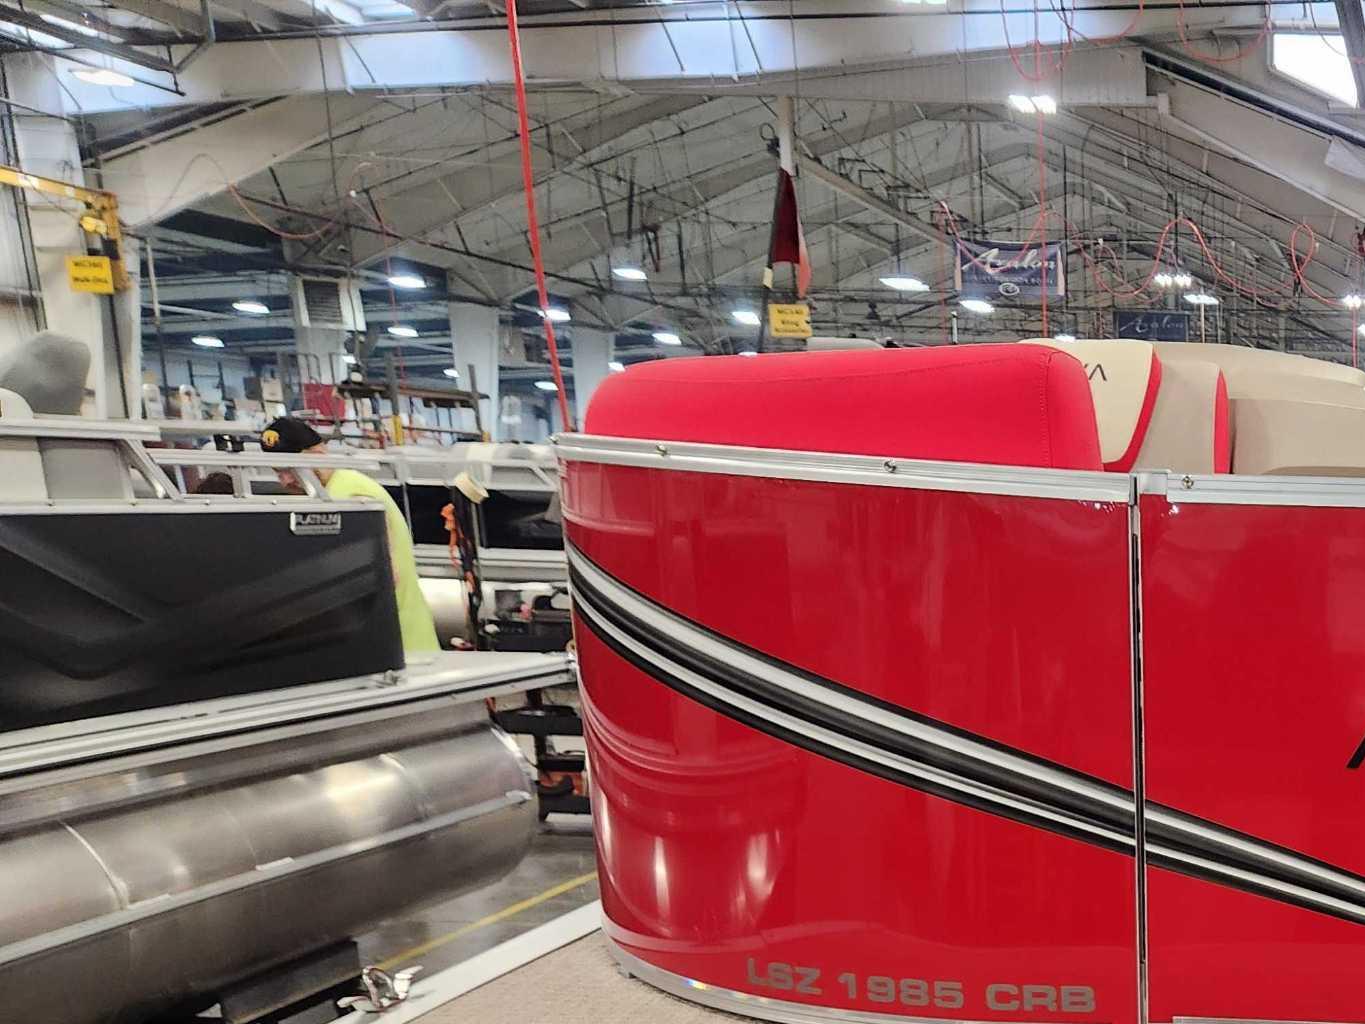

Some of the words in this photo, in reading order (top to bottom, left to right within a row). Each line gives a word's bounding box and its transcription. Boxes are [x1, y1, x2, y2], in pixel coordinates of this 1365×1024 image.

[746, 957, 823, 996] LSZ
[838, 973, 965, 1009] 1985
[984, 983, 1096, 1013] CRB
